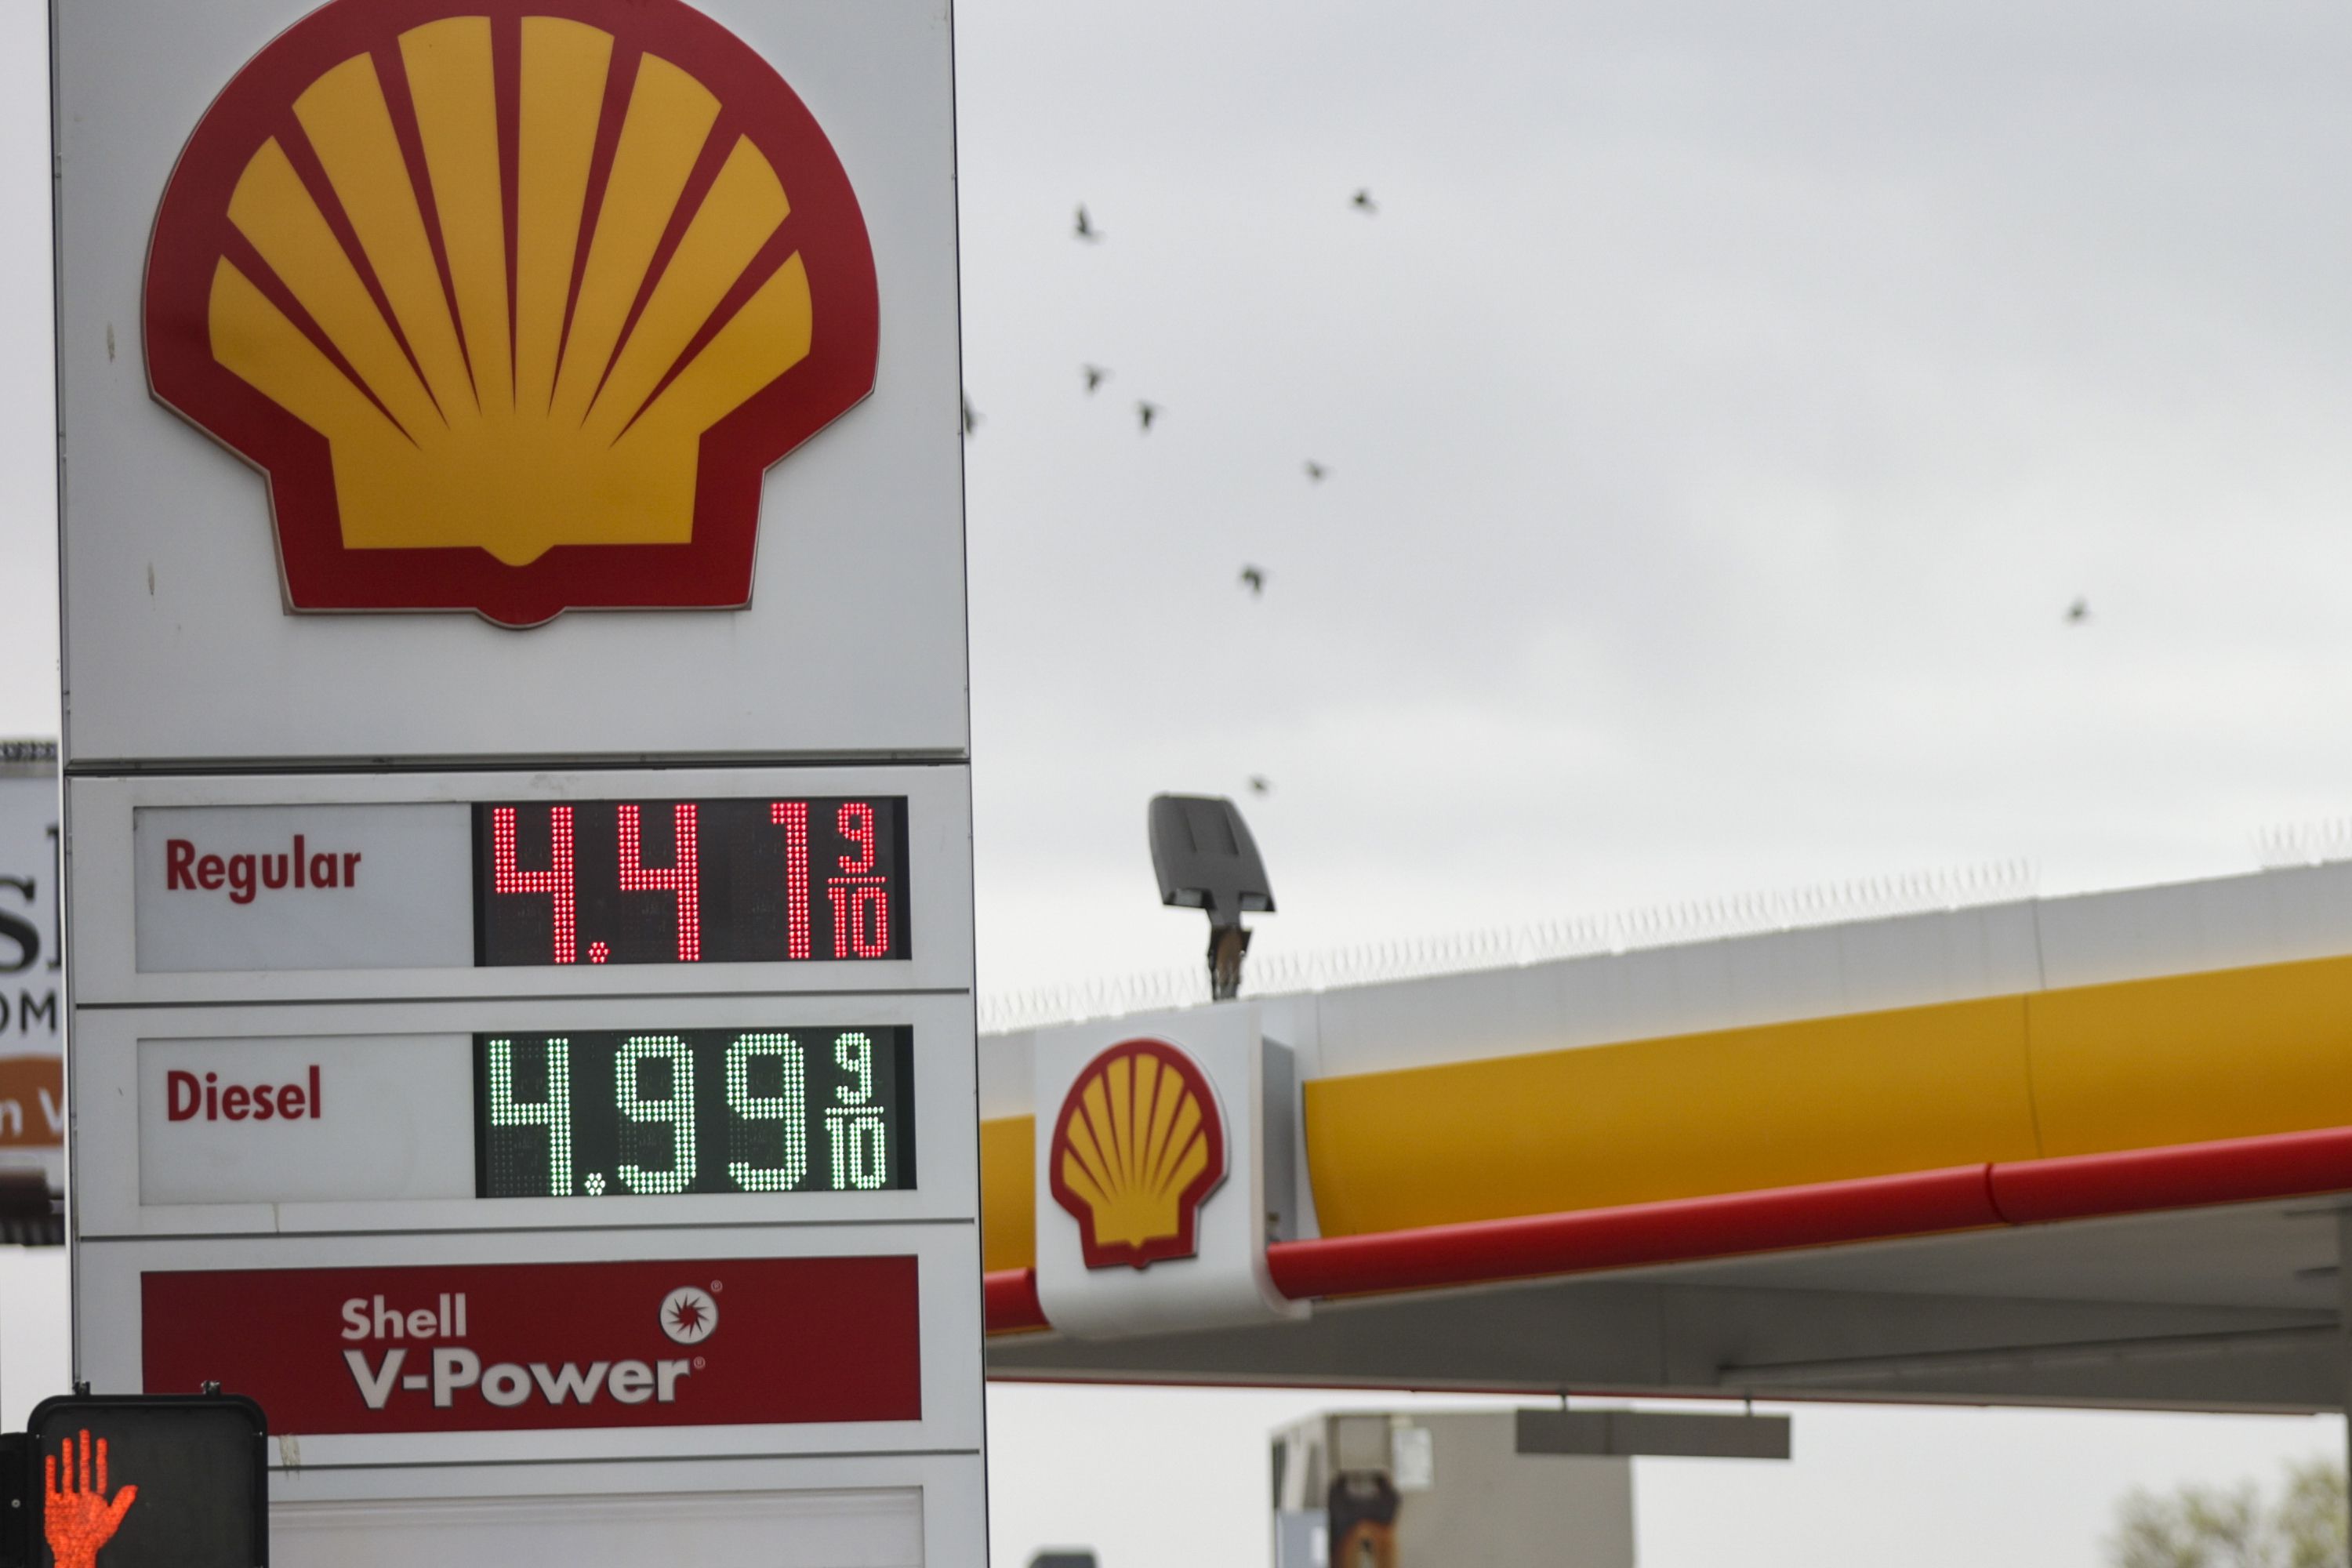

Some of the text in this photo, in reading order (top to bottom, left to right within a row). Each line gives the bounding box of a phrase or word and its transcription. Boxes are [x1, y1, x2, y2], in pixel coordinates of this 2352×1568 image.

[166, 803, 811, 963] Regular 4.41
[167, 1033, 807, 1196] Diesel 4.99
[341, 1292, 466, 1340] Shell
